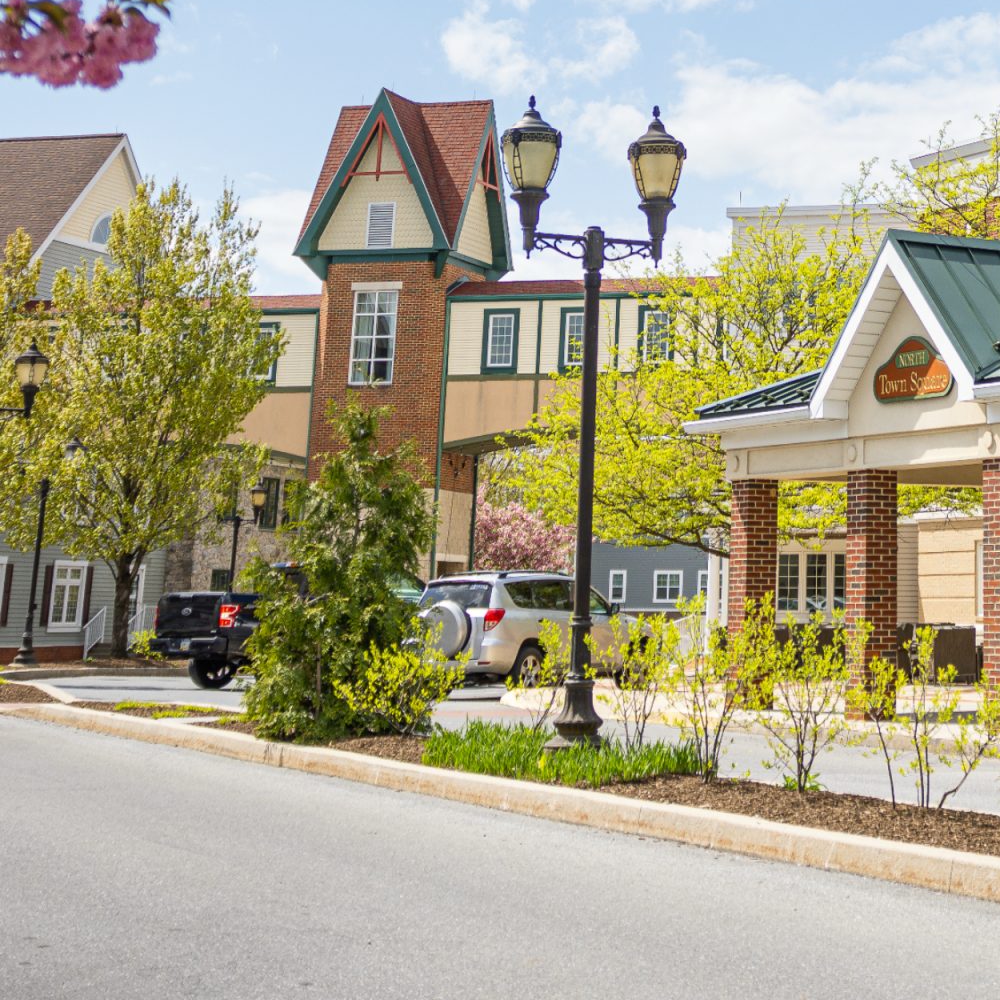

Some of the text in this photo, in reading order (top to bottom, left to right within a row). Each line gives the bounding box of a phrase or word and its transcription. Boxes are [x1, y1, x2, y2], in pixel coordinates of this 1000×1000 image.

[899, 351, 925, 367] NORTH
[878, 371, 948, 396] Town Square
